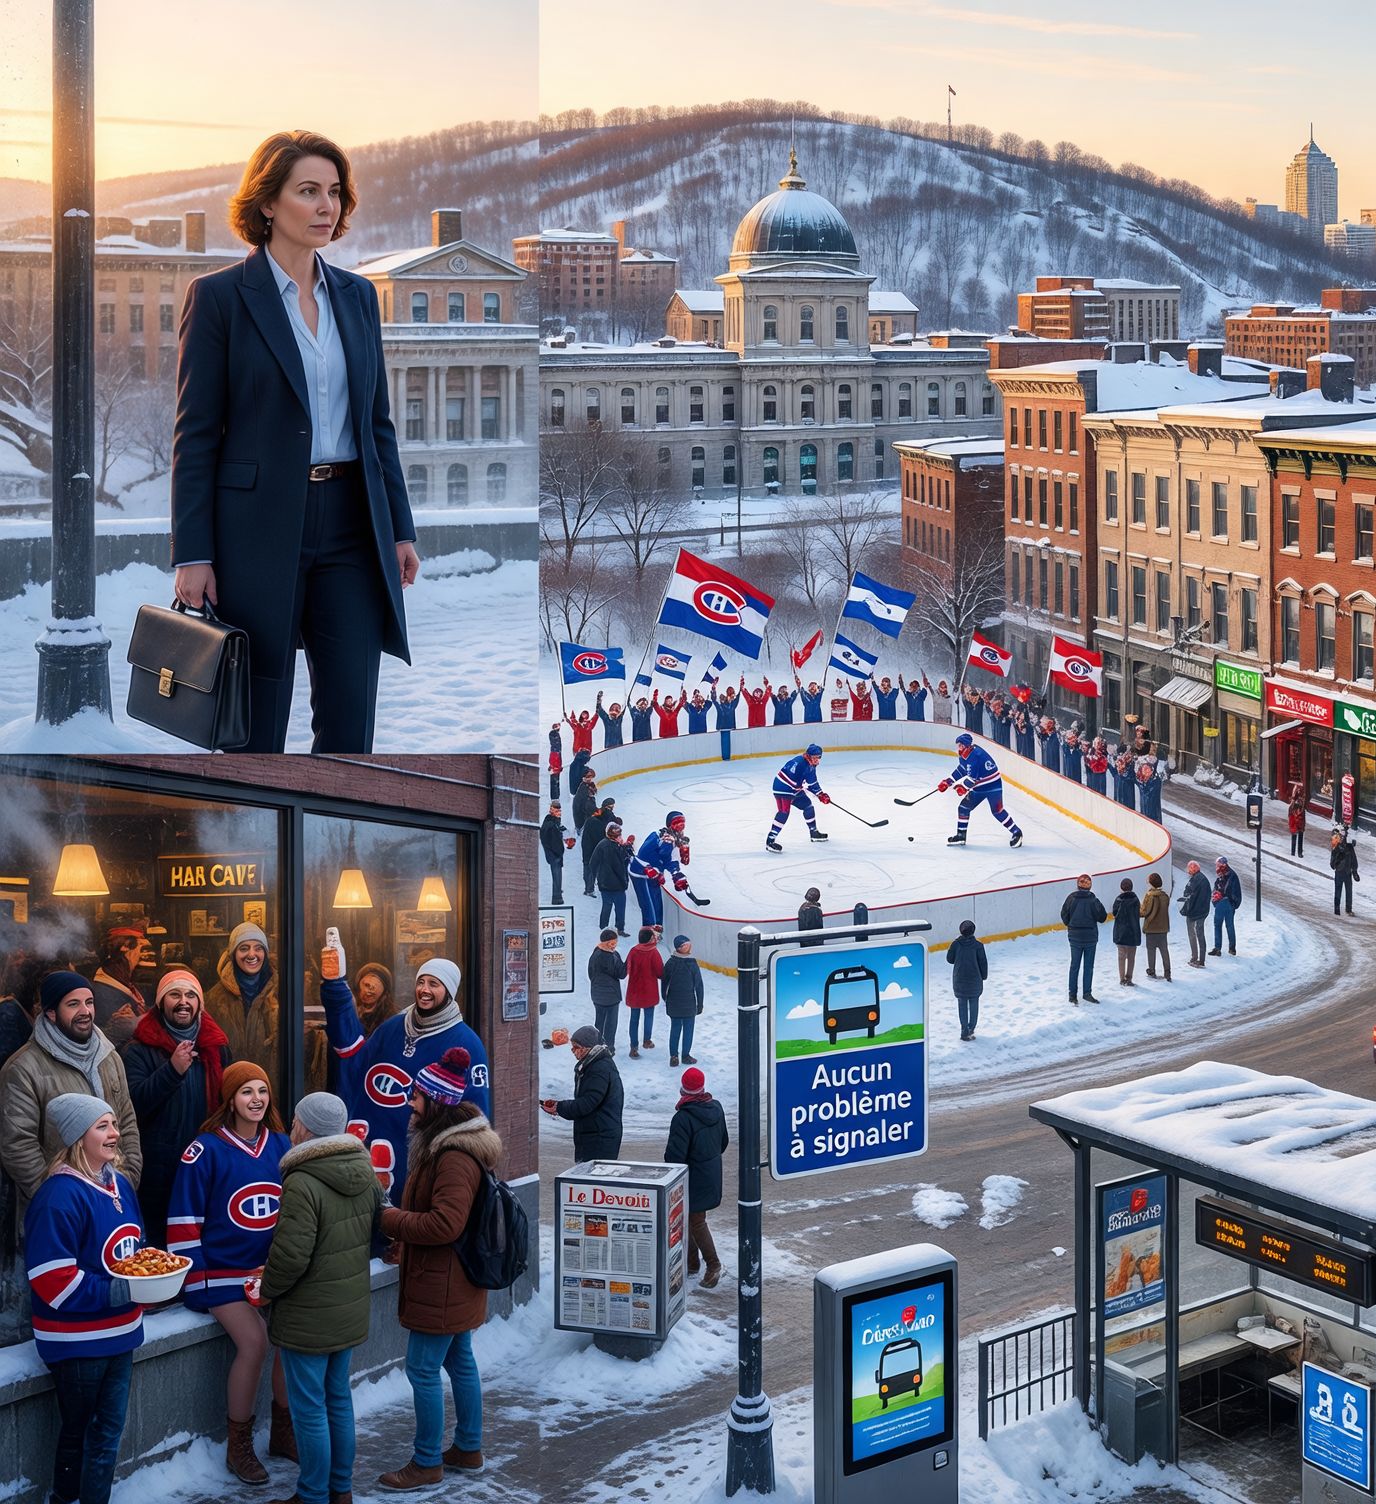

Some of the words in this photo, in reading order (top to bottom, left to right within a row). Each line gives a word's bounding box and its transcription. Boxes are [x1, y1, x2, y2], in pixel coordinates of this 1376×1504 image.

[210, 864, 256, 887] CAVE
[811, 1061, 892, 1090] Aucun
[791, 1090, 912, 1132] problème
[790, 1133, 805, 1158] à
[813, 1118, 914, 1157] signaler
